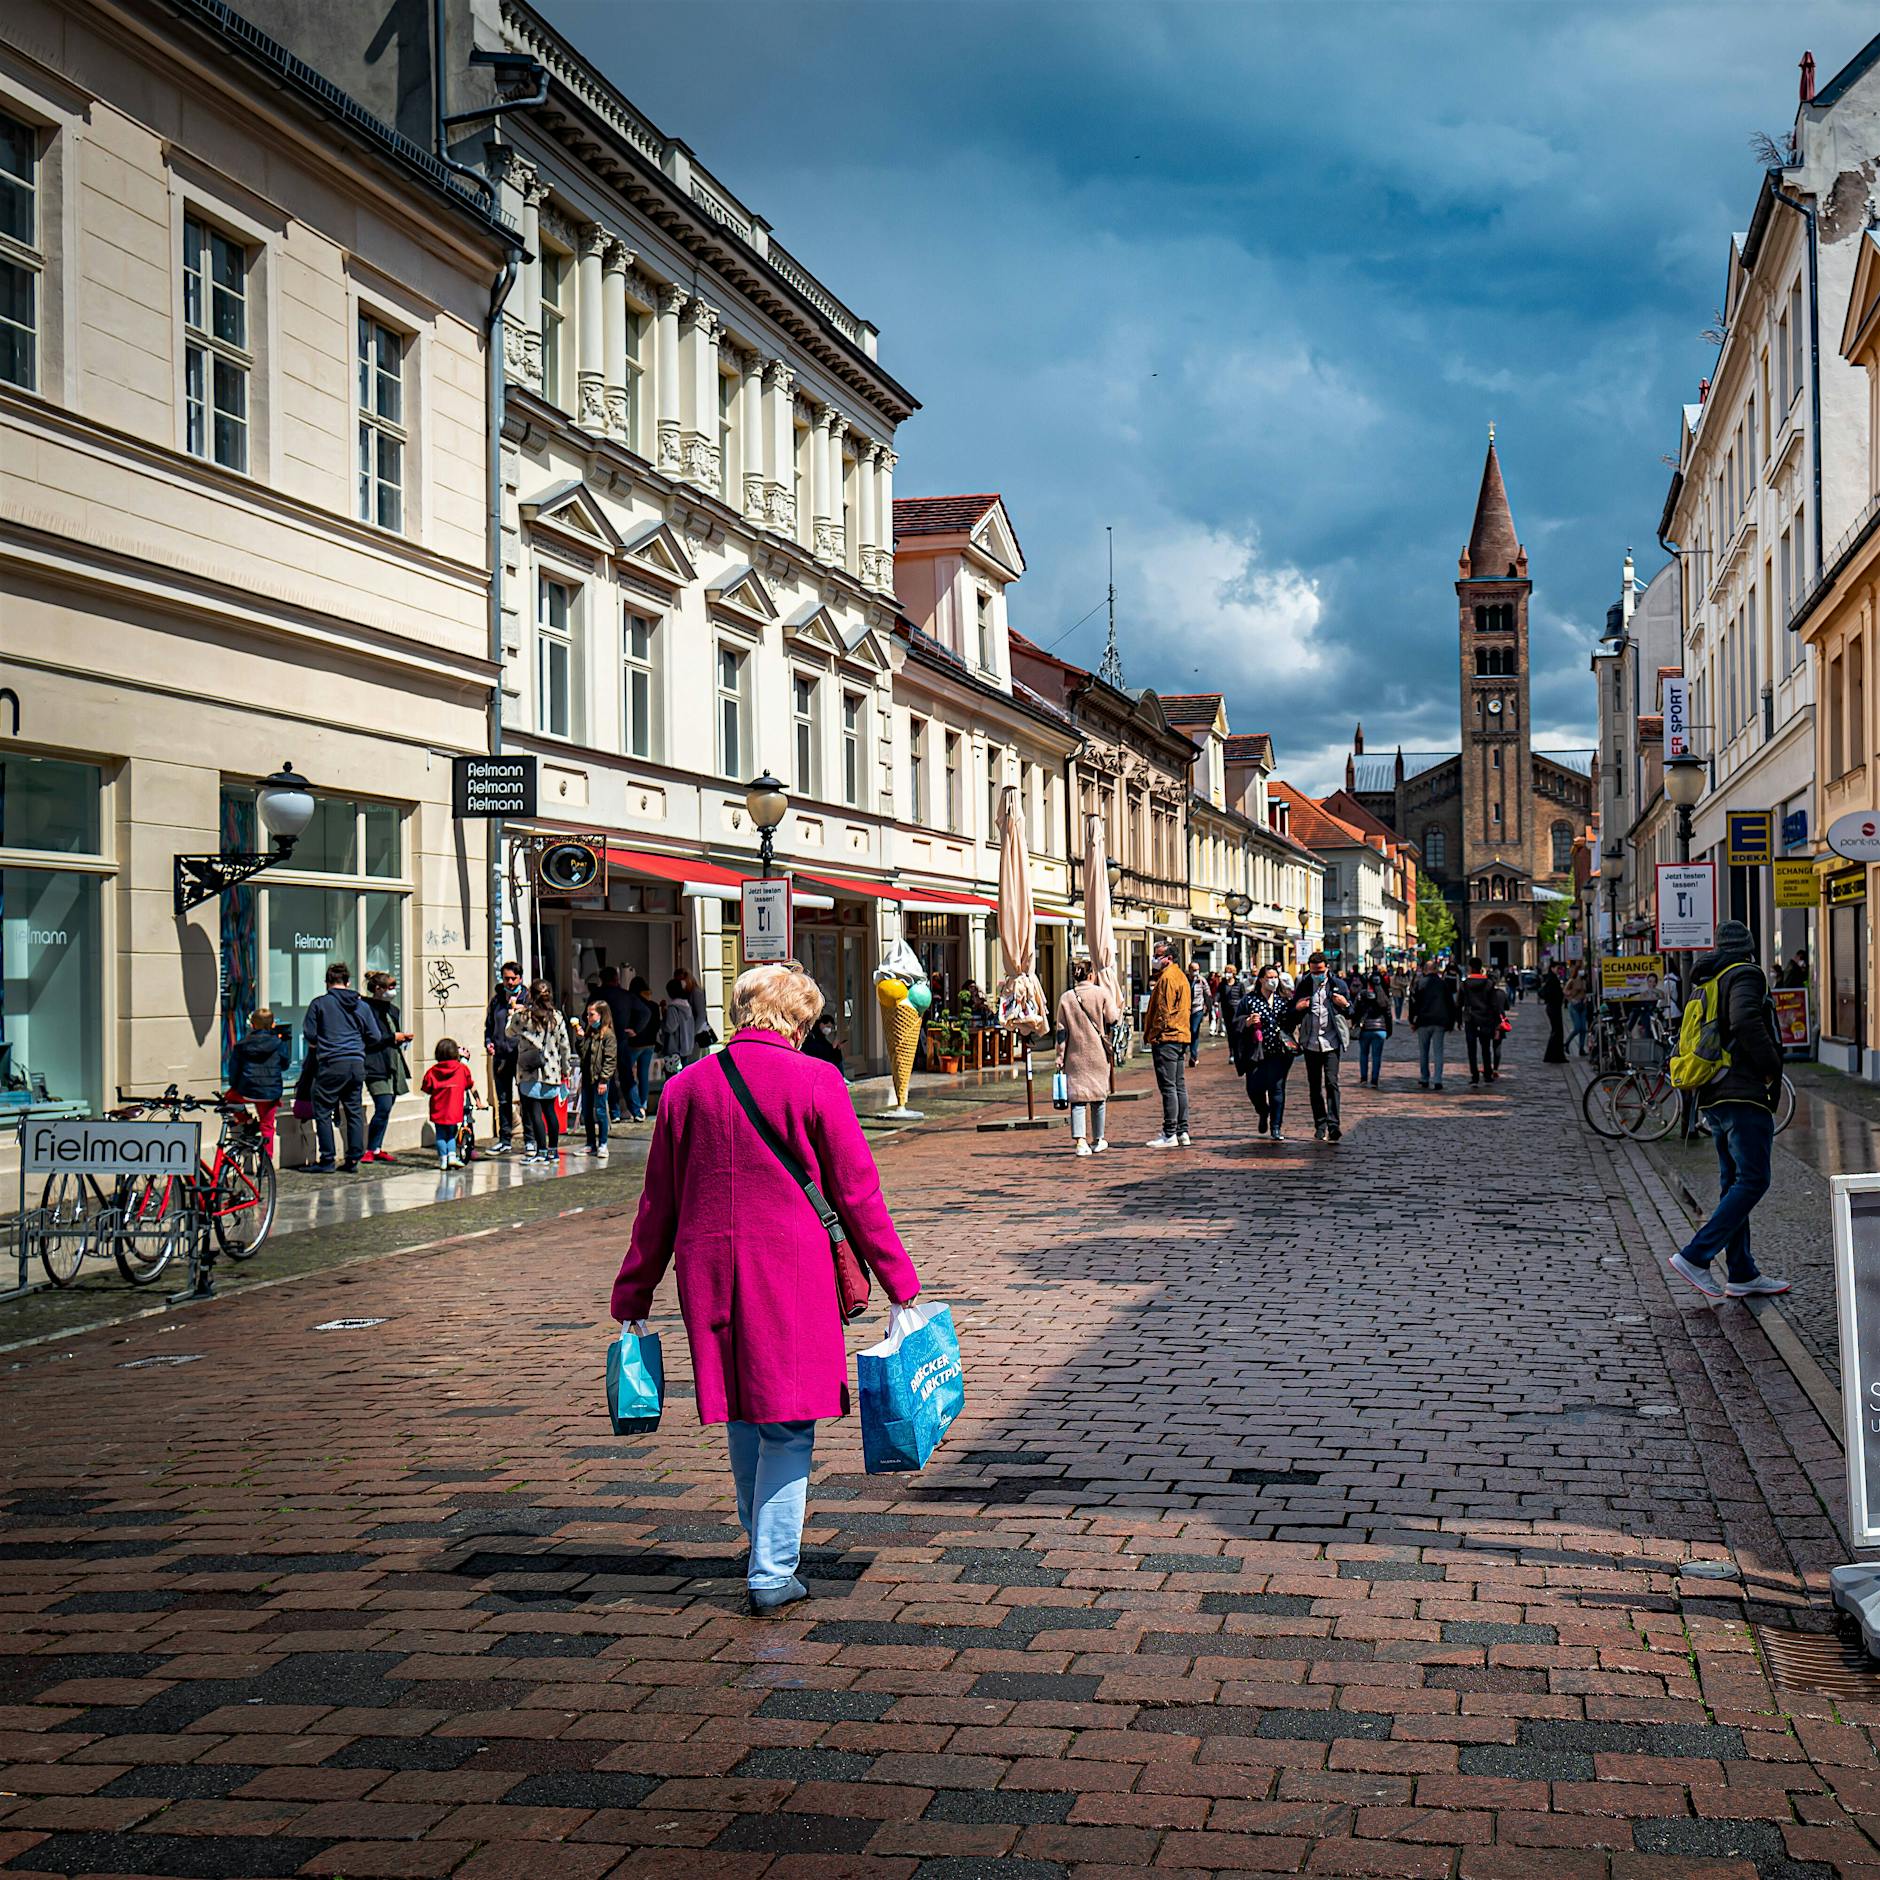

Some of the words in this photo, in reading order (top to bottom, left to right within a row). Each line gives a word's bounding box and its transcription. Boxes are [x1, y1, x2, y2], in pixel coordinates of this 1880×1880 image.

[1670, 684, 1682, 733] SPORT
[467, 762, 524, 777] fielmann
[467, 779, 524, 794] fielmann
[467, 796, 524, 811] fielmann
[1731, 854, 1768, 862] EDEKA
[294, 932, 334, 949] fielmann
[34, 1128, 187, 1163] fielmann
